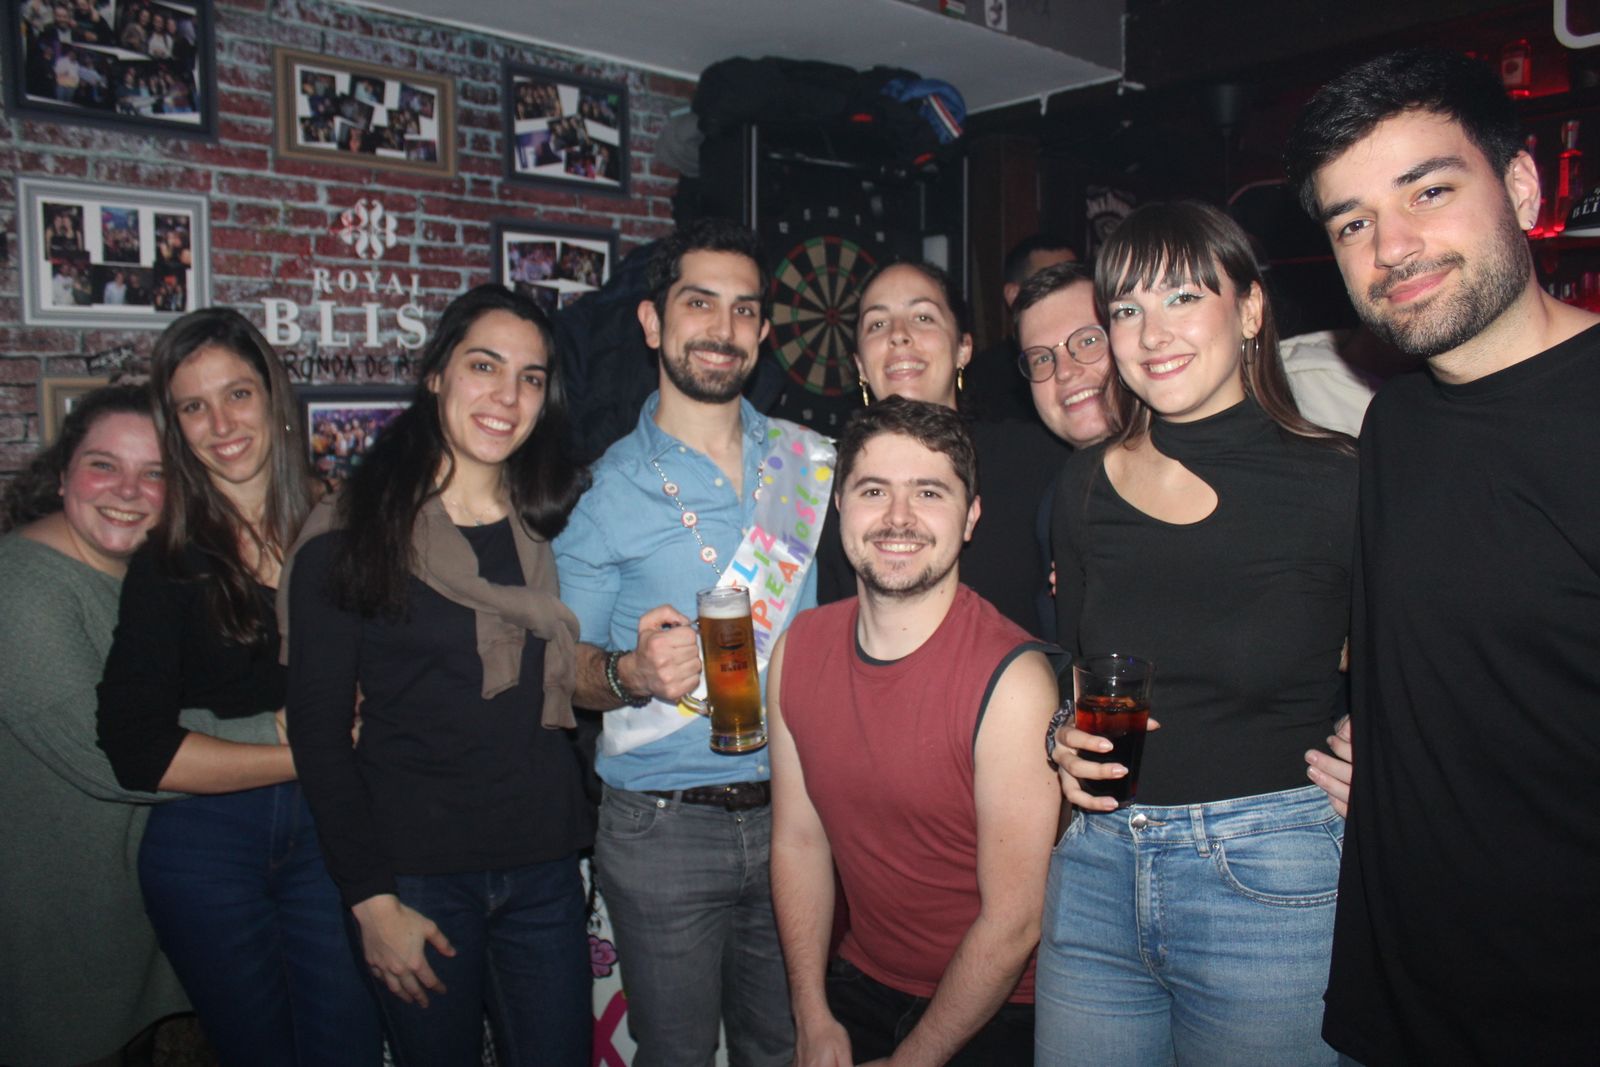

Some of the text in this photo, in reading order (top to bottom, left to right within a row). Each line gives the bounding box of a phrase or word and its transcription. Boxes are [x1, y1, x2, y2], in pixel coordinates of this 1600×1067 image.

[312, 267, 426, 297] ROYAL
[261, 299, 428, 349] BLIS
[731, 523, 777, 590] LIZ
